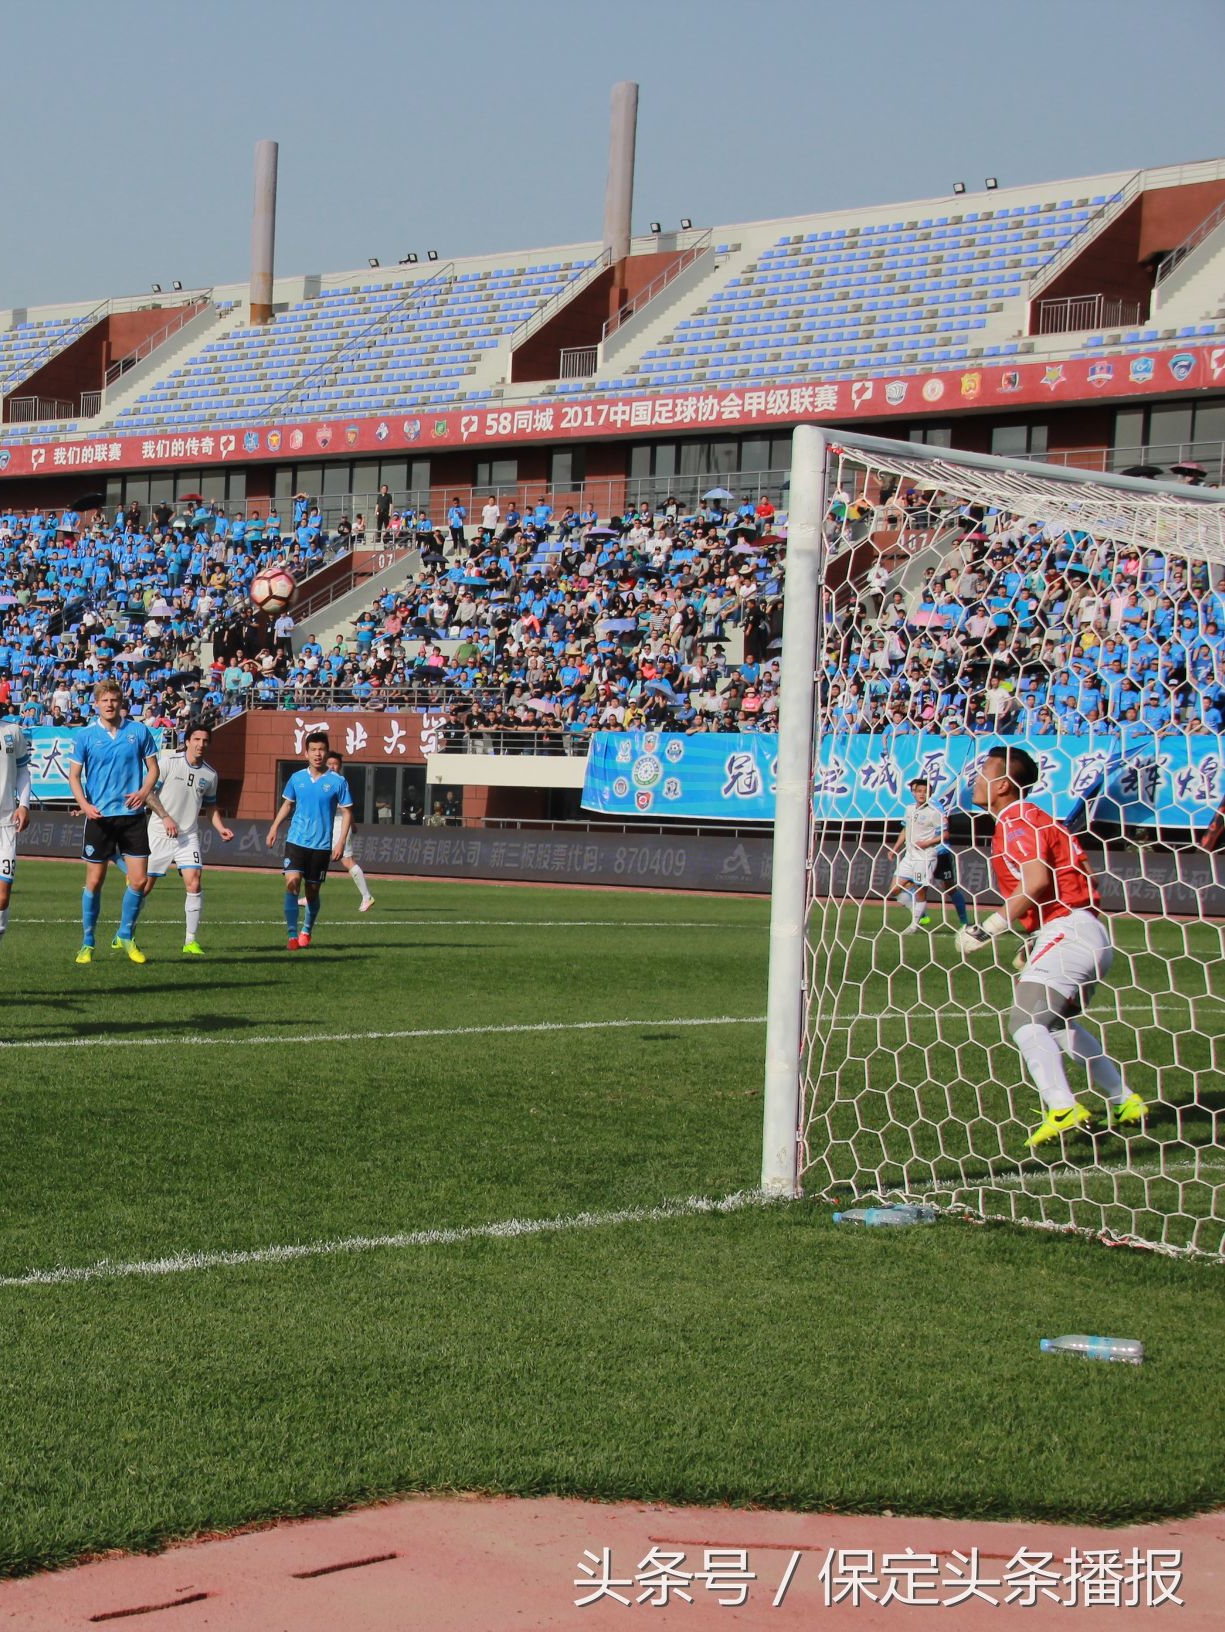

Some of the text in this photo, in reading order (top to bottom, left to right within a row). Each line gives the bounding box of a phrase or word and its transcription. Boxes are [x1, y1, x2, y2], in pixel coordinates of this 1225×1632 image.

[485, 384, 839, 436] 58同城 2017中国足球协会甲级联赛
[53, 437, 214, 466] 我们的联赛 我们的传奇
[186, 773, 195, 787] 9
[192, 851, 200, 864] 9
[614, 847, 686, 877] 870409
